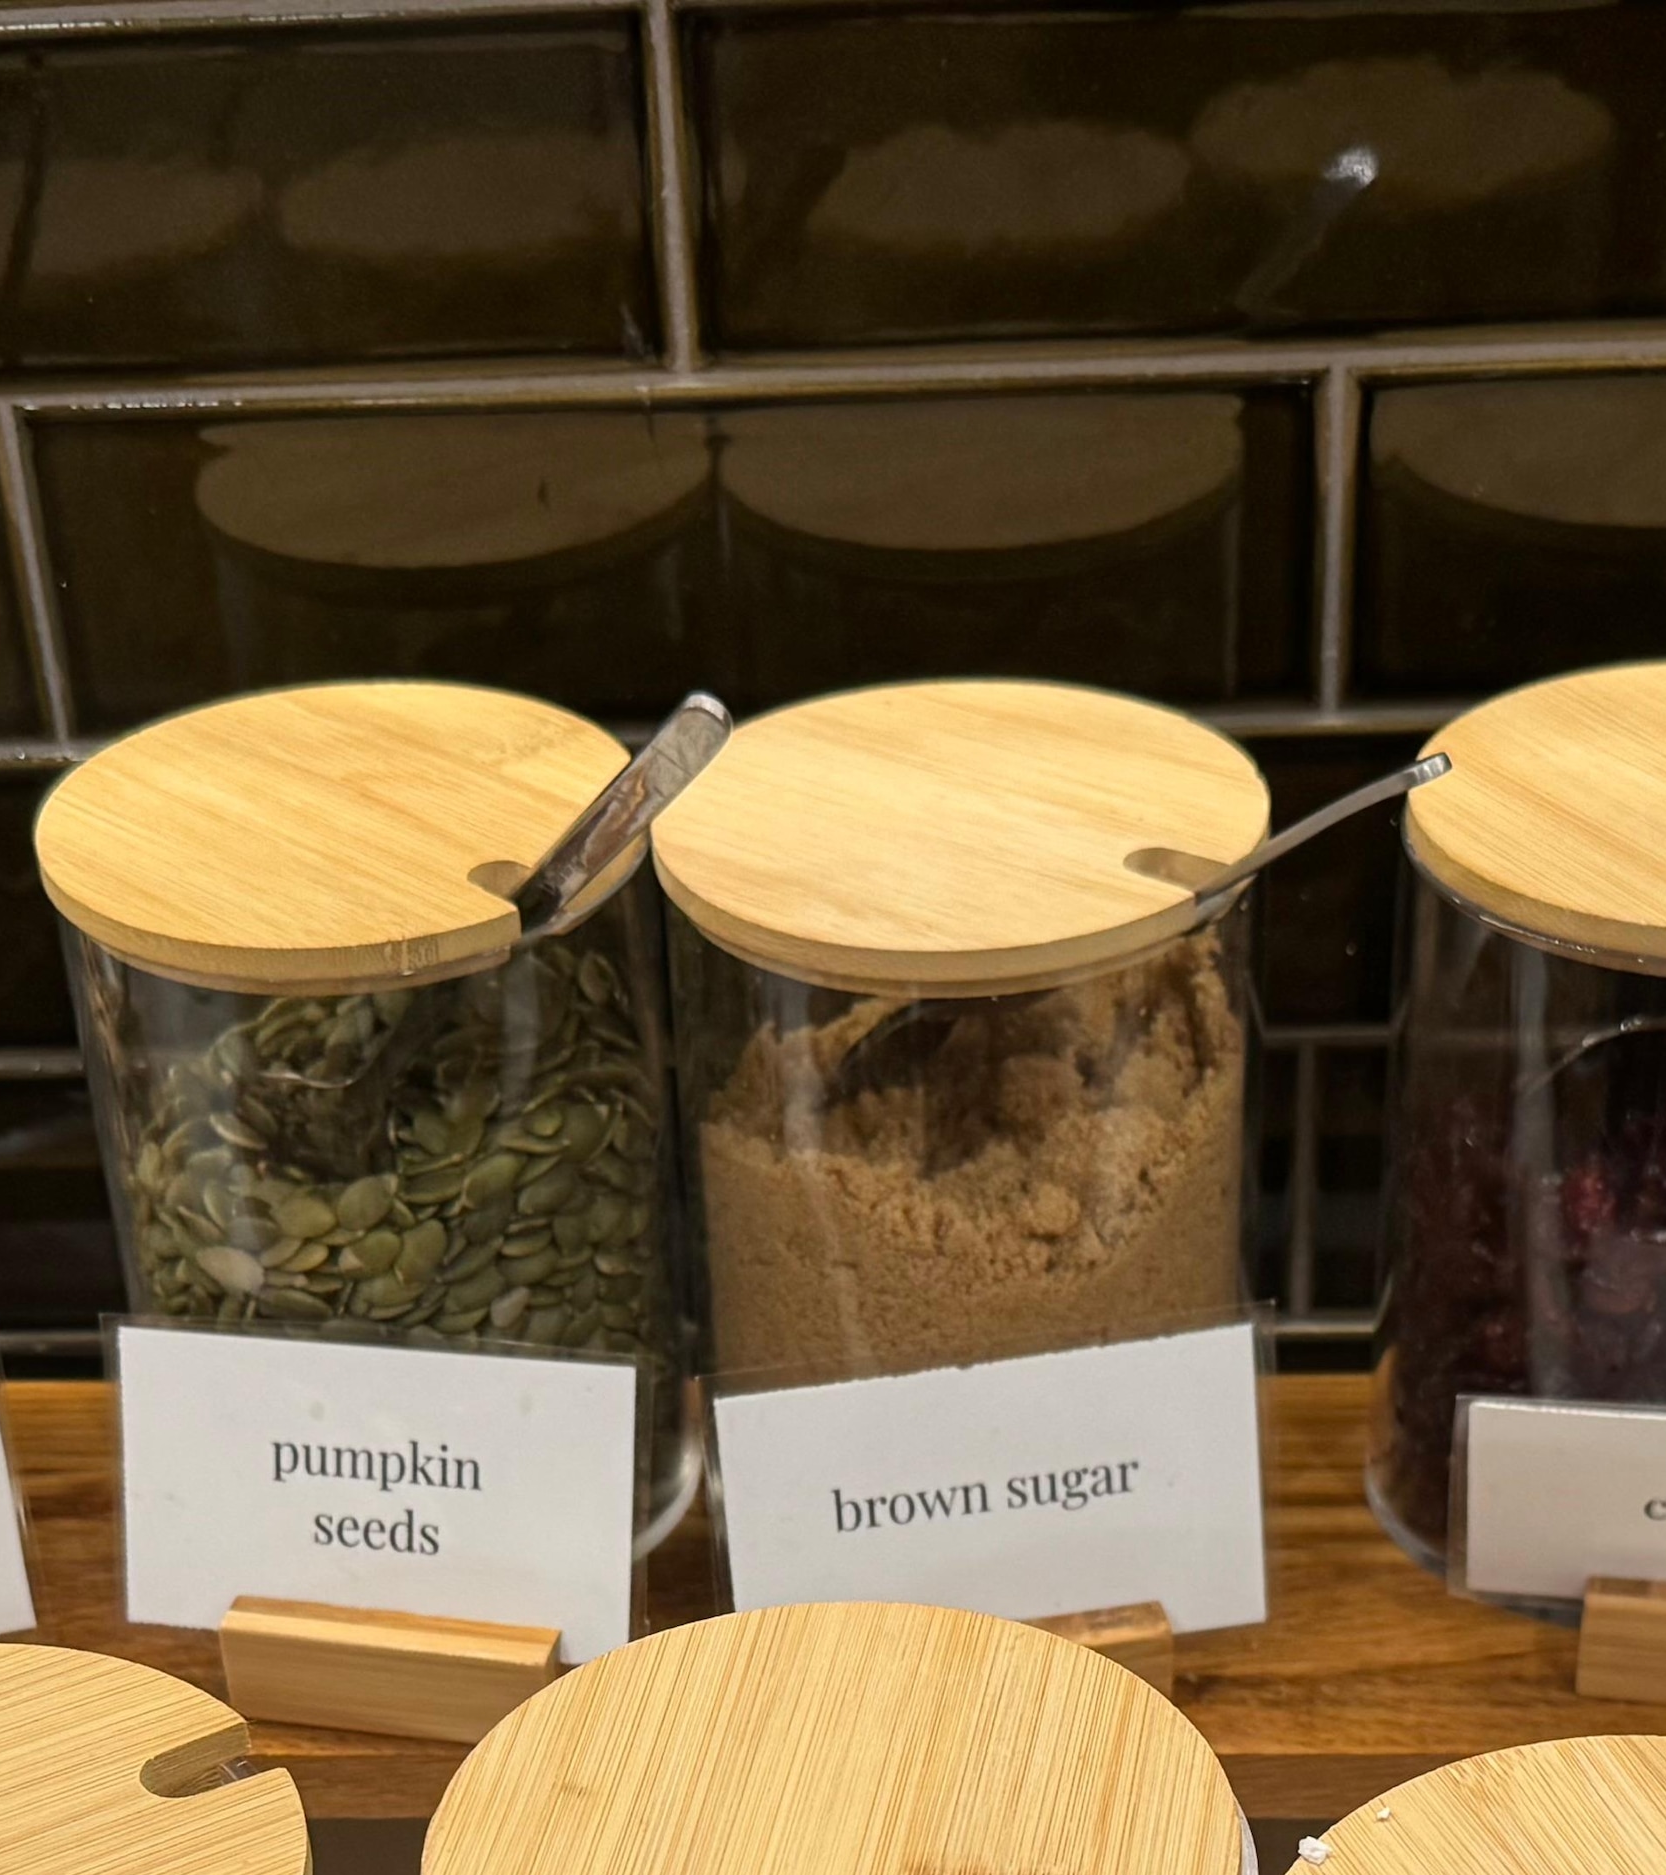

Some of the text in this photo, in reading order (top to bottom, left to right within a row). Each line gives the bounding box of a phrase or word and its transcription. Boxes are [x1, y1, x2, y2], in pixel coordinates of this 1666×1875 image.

[272, 1440, 482, 1493] pumpkin
[832, 1461, 1140, 1533] brown sugar
[314, 1508, 441, 1557] seeds
